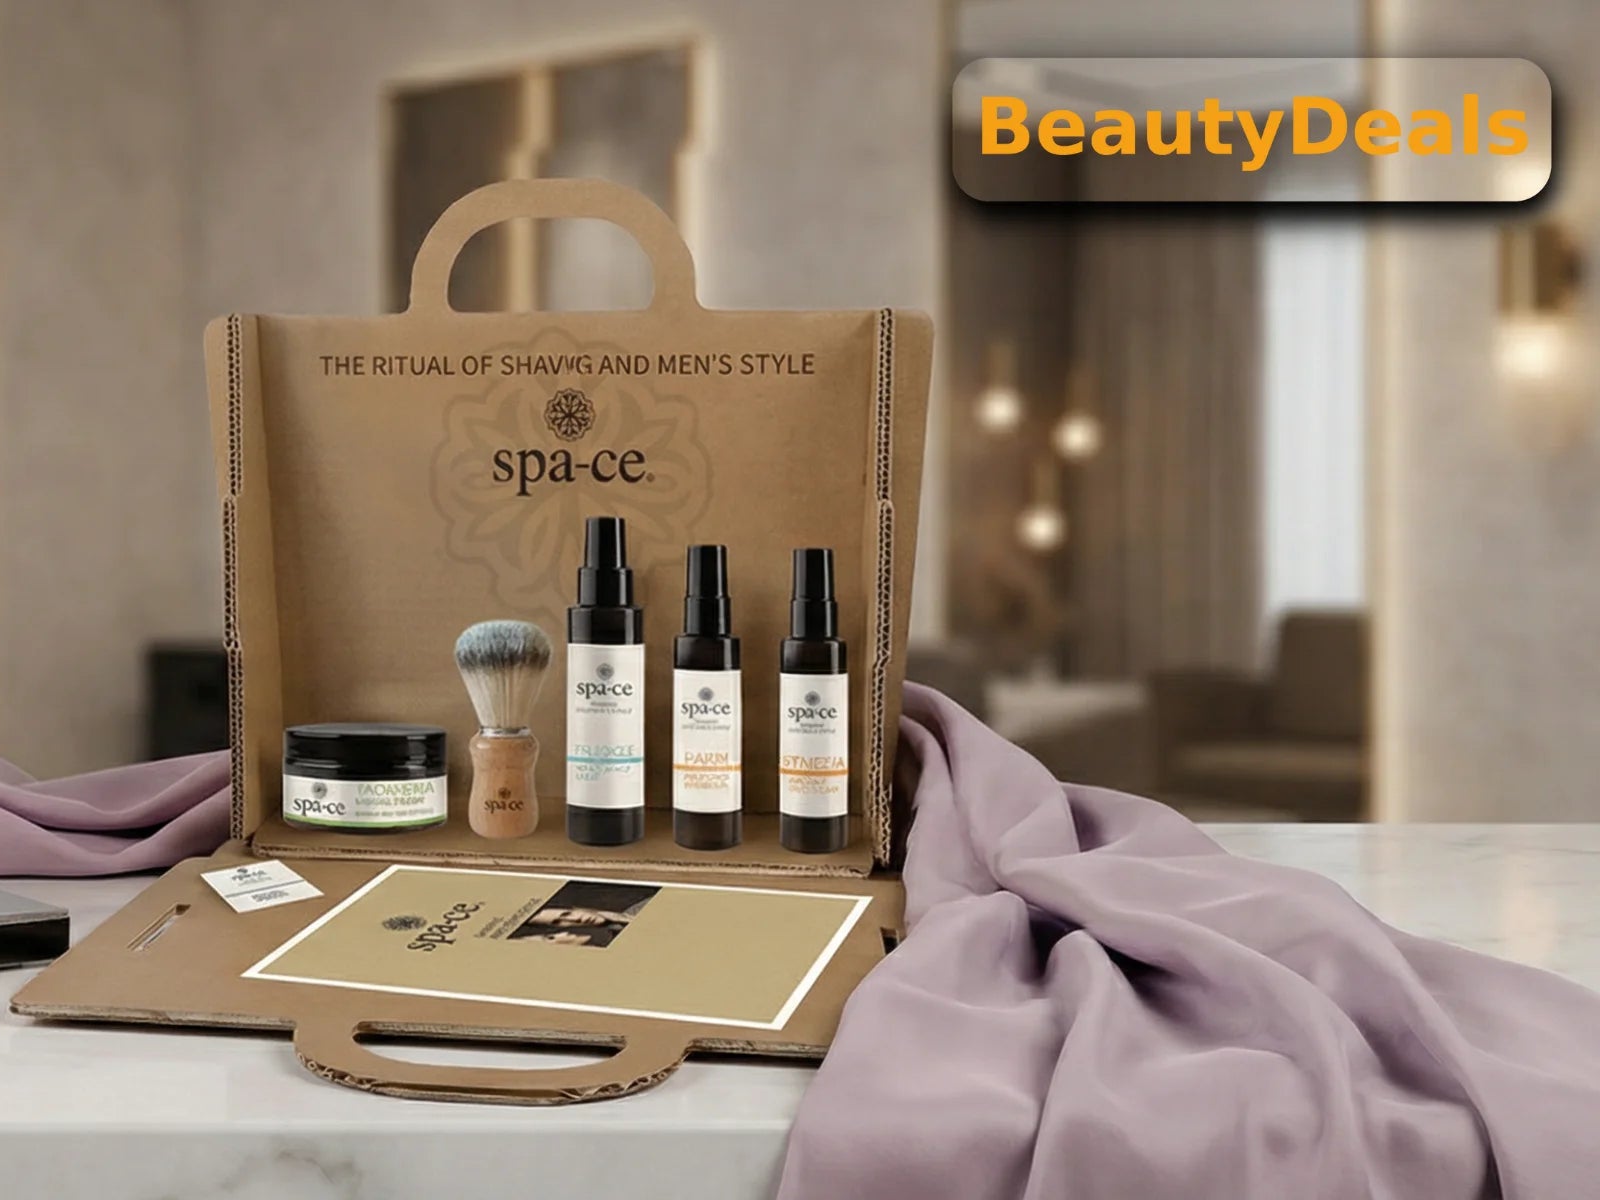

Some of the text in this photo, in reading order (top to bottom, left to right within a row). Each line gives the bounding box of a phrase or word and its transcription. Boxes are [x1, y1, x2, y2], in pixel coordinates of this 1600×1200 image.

[319, 355, 365, 376] THE
[372, 355, 456, 376] RITUAL
[461, 354, 494, 376] OF
[599, 354, 650, 375] AND
[657, 353, 733, 375] MEN'S
[740, 353, 816, 375] STYLE
